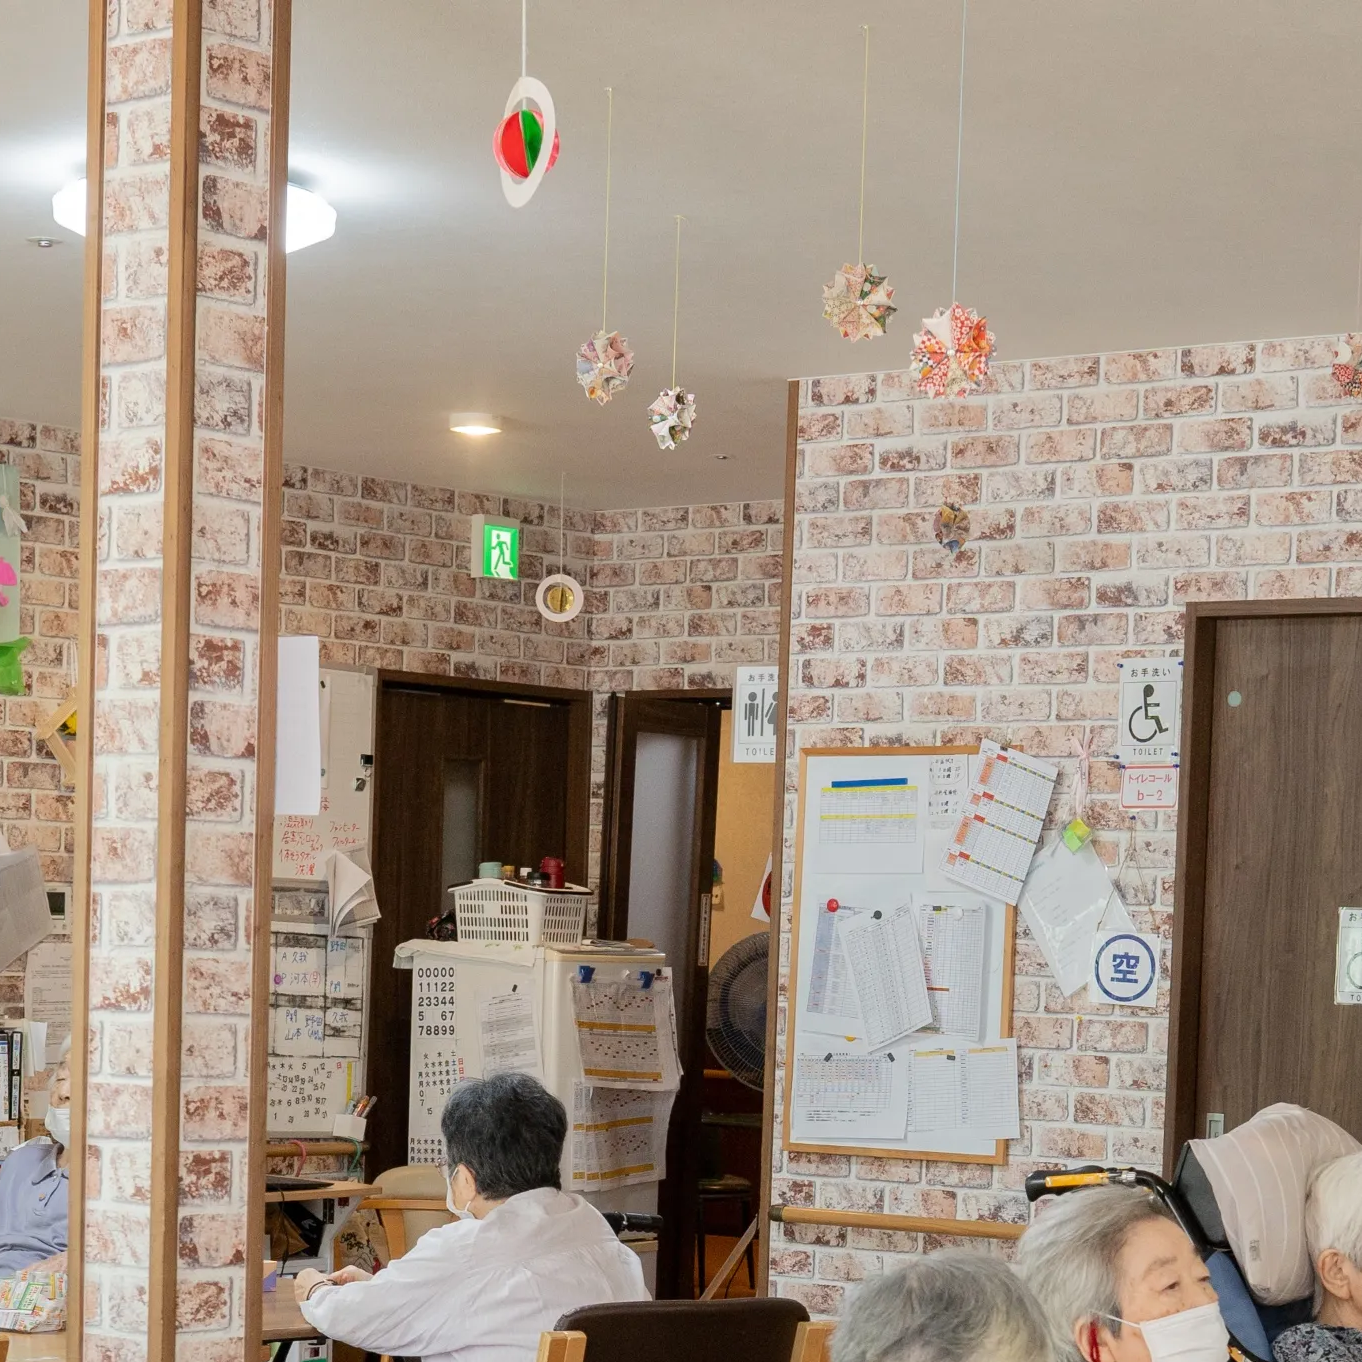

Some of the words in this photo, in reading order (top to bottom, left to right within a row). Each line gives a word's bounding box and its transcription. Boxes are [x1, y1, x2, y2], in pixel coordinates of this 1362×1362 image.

[748, 673, 775, 682] お手洗
[1131, 668, 1170, 677] お手洗い
[1128, 774, 1172, 784] トイレコール
[1110, 952, 1140, 983] 空
[418, 968, 454, 978] 00000
[419, 982, 455, 992] 11122
[418, 996, 455, 1007] 23344
[418, 1011, 424, 1021] 5
[418, 1025, 455, 1035] 78899
